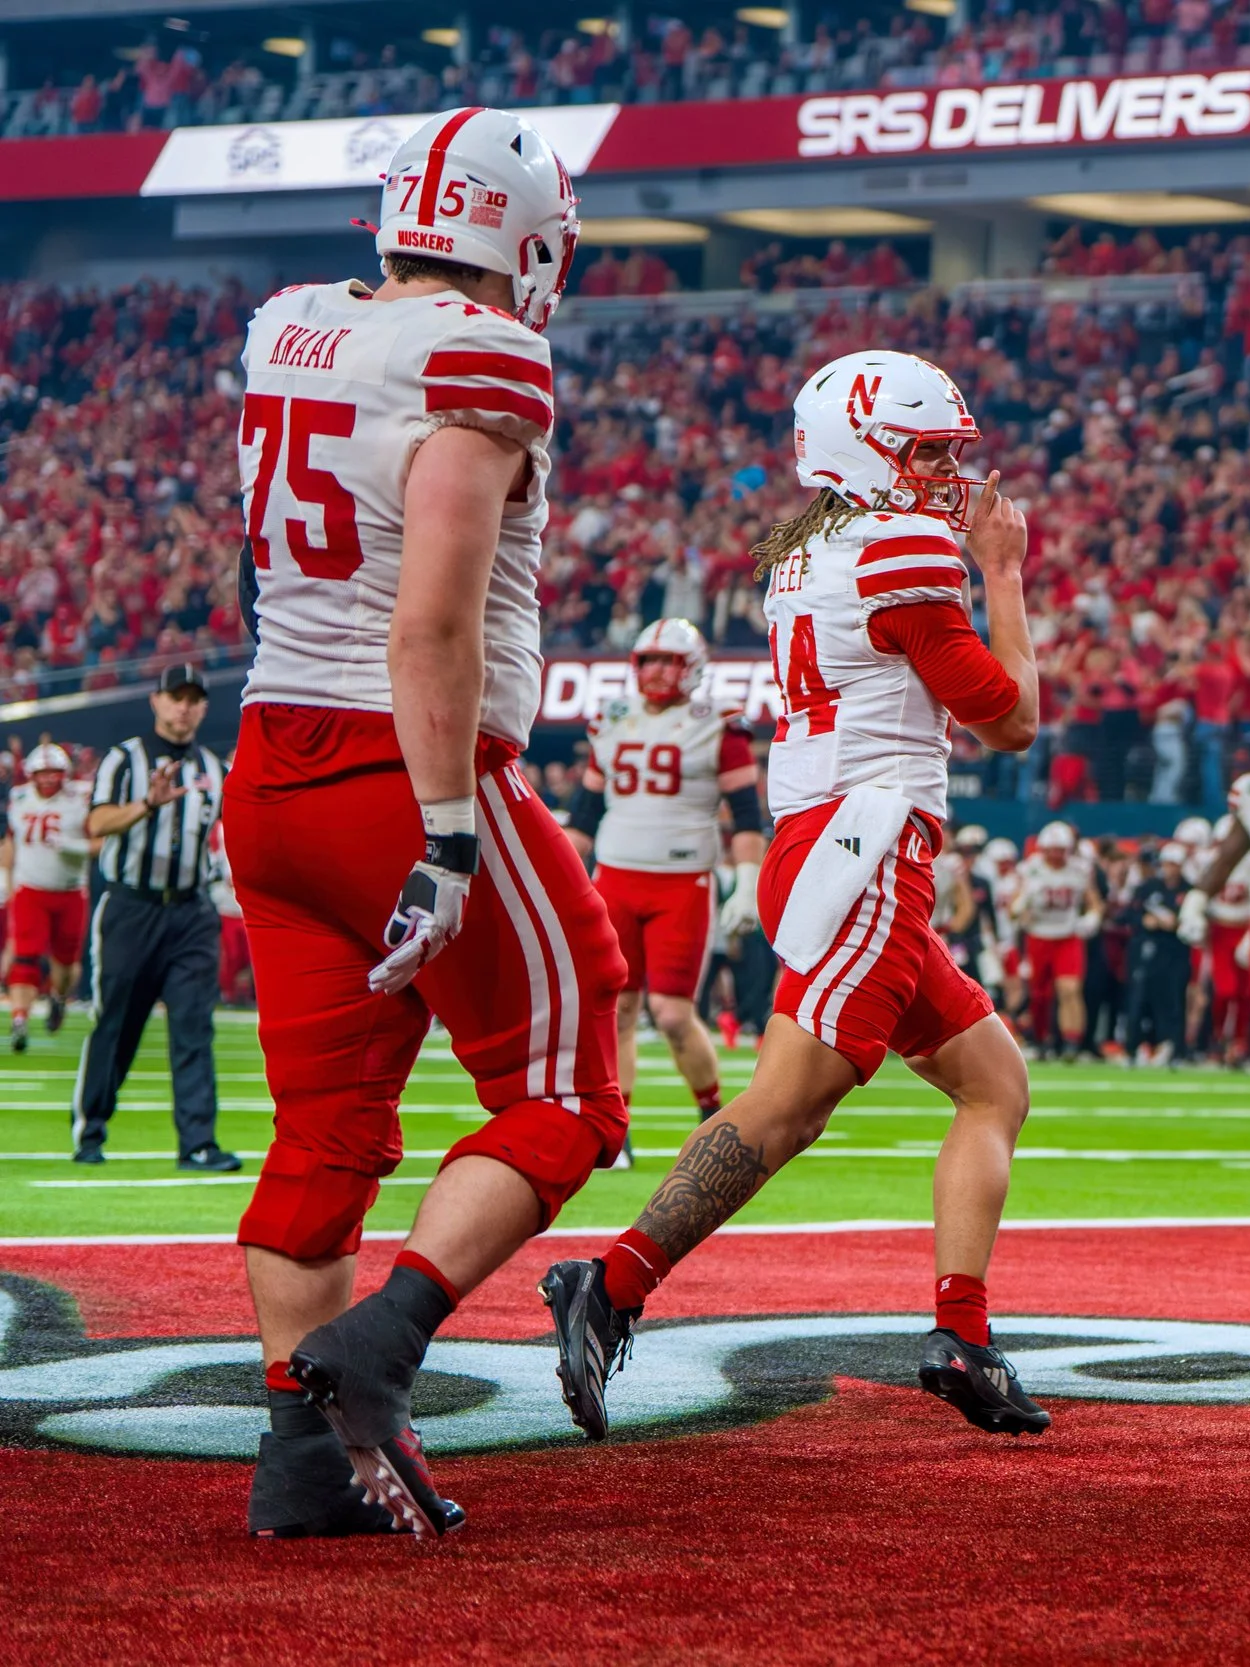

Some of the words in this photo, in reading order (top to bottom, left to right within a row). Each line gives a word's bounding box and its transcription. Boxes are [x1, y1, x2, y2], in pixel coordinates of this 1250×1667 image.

[798, 92, 928, 157] SRS
[397, 230, 454, 253] HUSKERS
[268, 324, 352, 370] KNAAK
[846, 374, 882, 416] N
[241, 392, 365, 581] 75
[503, 764, 531, 801] N
[612, 742, 682, 796] 59
[906, 831, 923, 864] N
